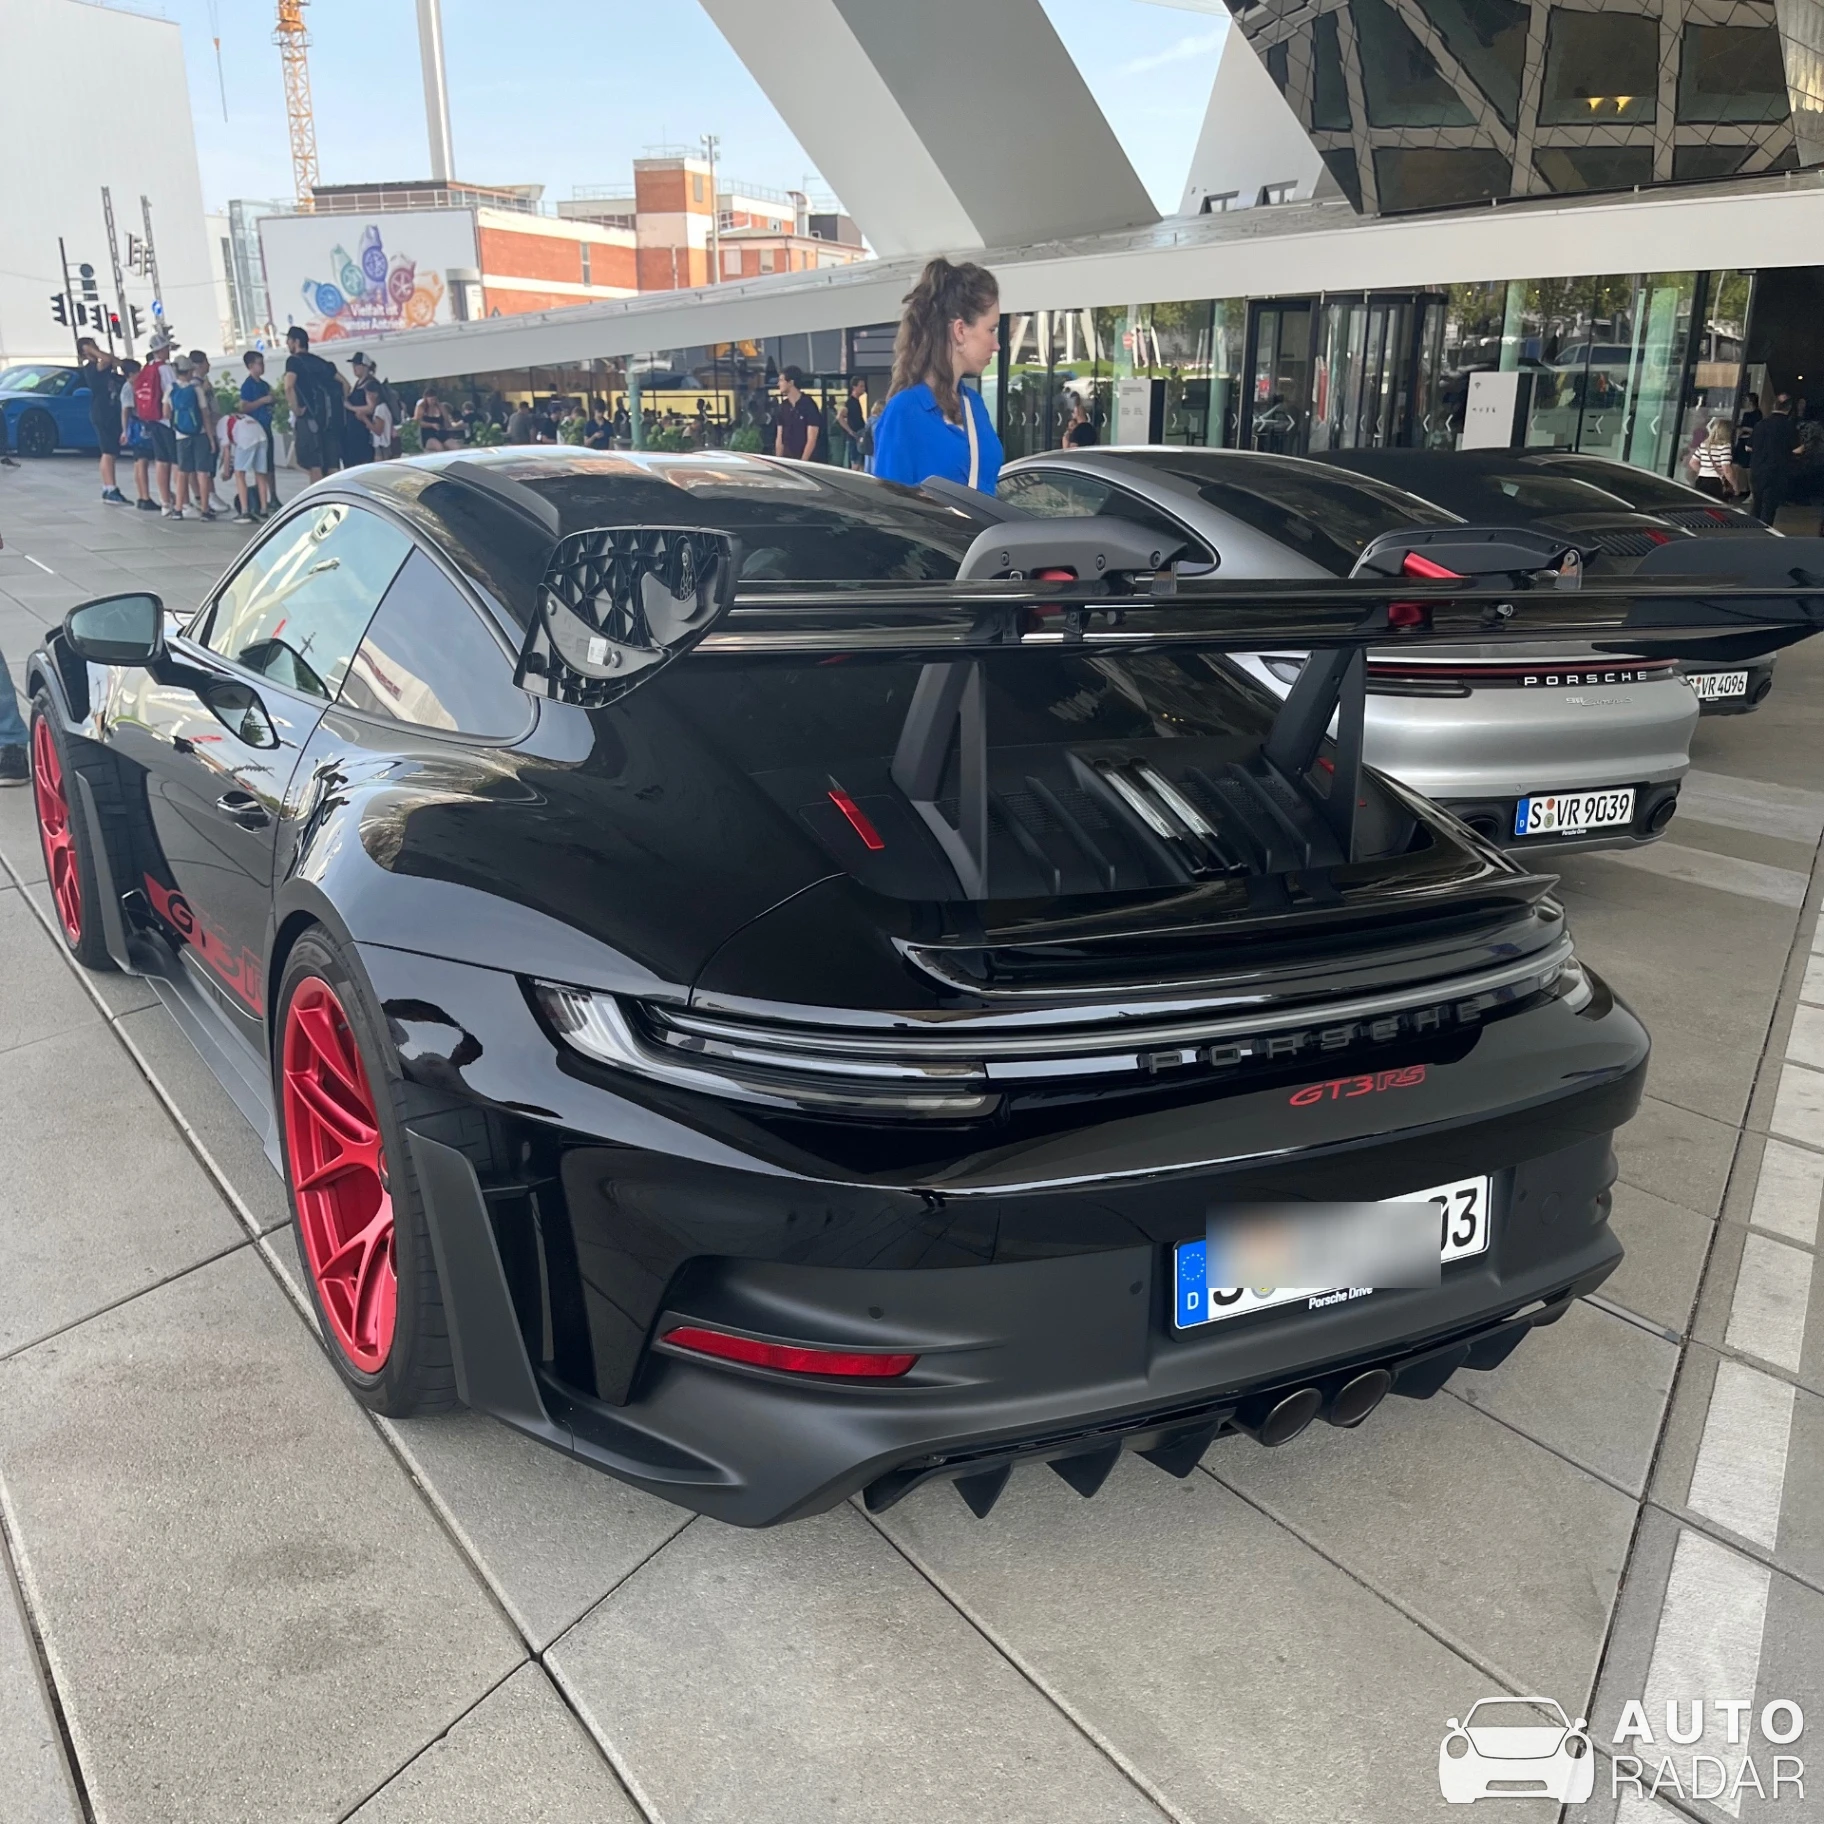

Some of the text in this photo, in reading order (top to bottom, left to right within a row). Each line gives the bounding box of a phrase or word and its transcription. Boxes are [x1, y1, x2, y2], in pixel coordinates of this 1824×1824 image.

[1524, 671, 1647, 686] PORSCHE
[1702, 675, 1744, 695] VR 4096
[1529, 794, 1630, 828] S VR 9039
[1149, 1001, 1482, 1074] PORSCHE
[1187, 1291, 1199, 1311] D
[1308, 1288, 1373, 1310] Porsche Drive
